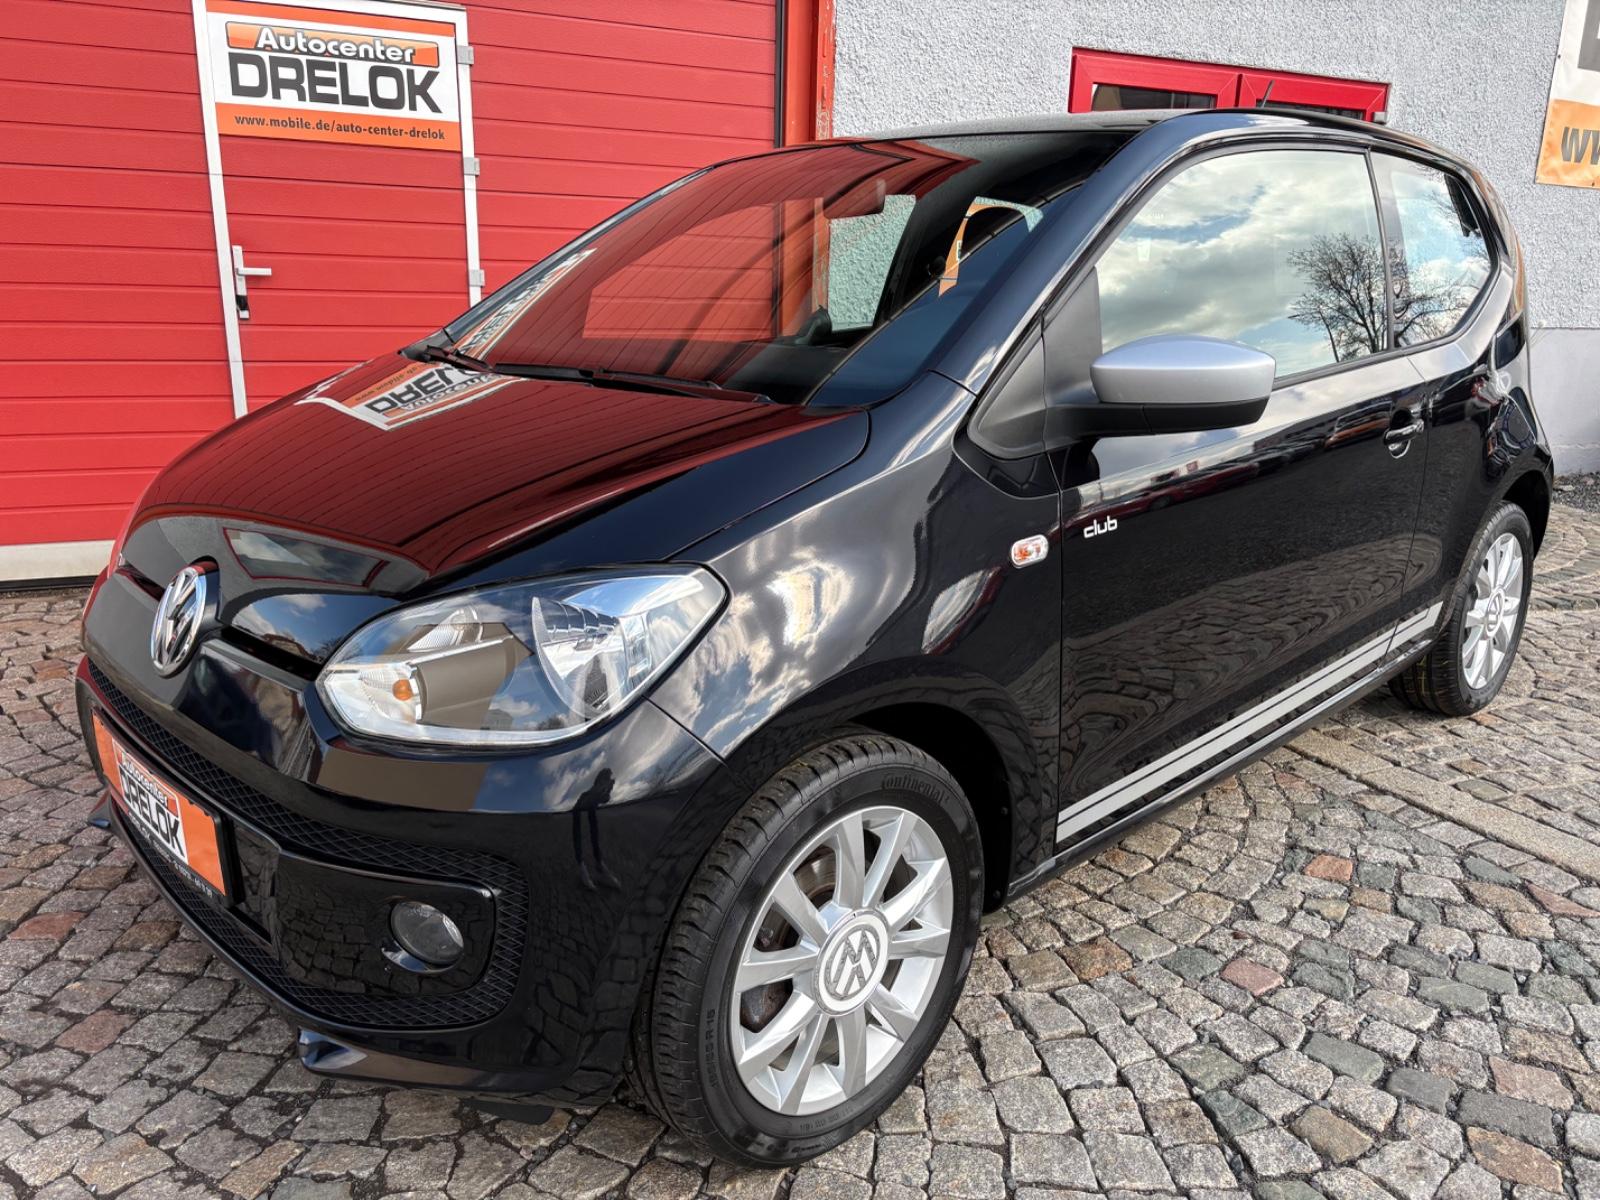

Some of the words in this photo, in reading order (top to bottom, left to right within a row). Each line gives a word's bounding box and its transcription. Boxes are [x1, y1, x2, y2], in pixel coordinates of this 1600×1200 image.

[255, 26, 417, 65] Autocenter
[228, 51, 443, 114] DRELOK
[234, 113, 446, 141] www.mobile.de/auto-center-drelok
[1083, 515, 1118, 539] club
[151, 566, 207, 678] VW
[118, 764, 186, 859] DRELOK
